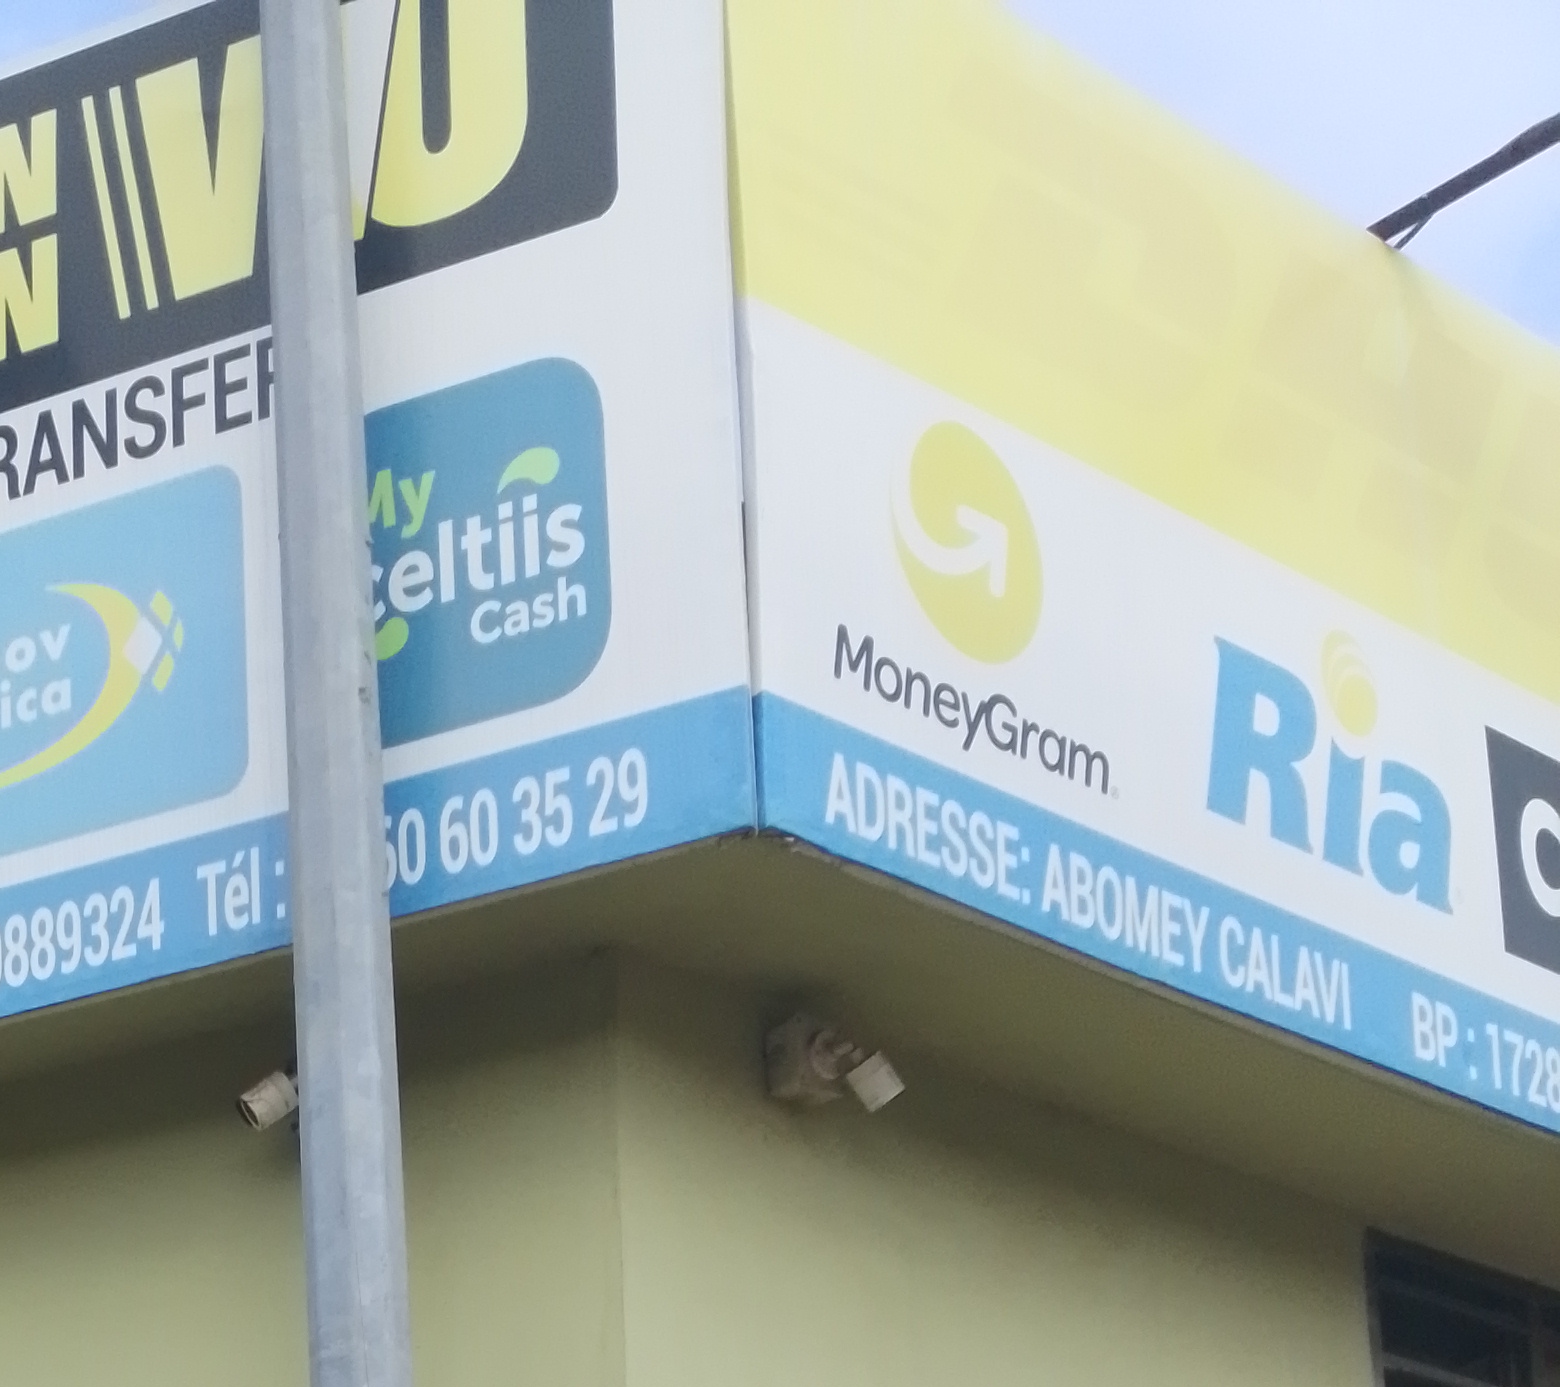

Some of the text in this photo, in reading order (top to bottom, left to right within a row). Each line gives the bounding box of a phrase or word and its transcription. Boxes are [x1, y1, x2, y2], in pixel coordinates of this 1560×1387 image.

[372, 494, 586, 621] eltiis
[470, 576, 587, 644] Cash
[834, 623, 1111, 796] MoneyGram
[1206, 630, 1454, 916] Ria
[440, 788, 499, 874] 60
[513, 766, 573, 855] 35
[586, 747, 648, 837] 29
[825, 751, 1032, 906] ADRESSE:
[1042, 842, 1211, 975] ABOMEY
[1220, 915, 1352, 1031] CALAVI
